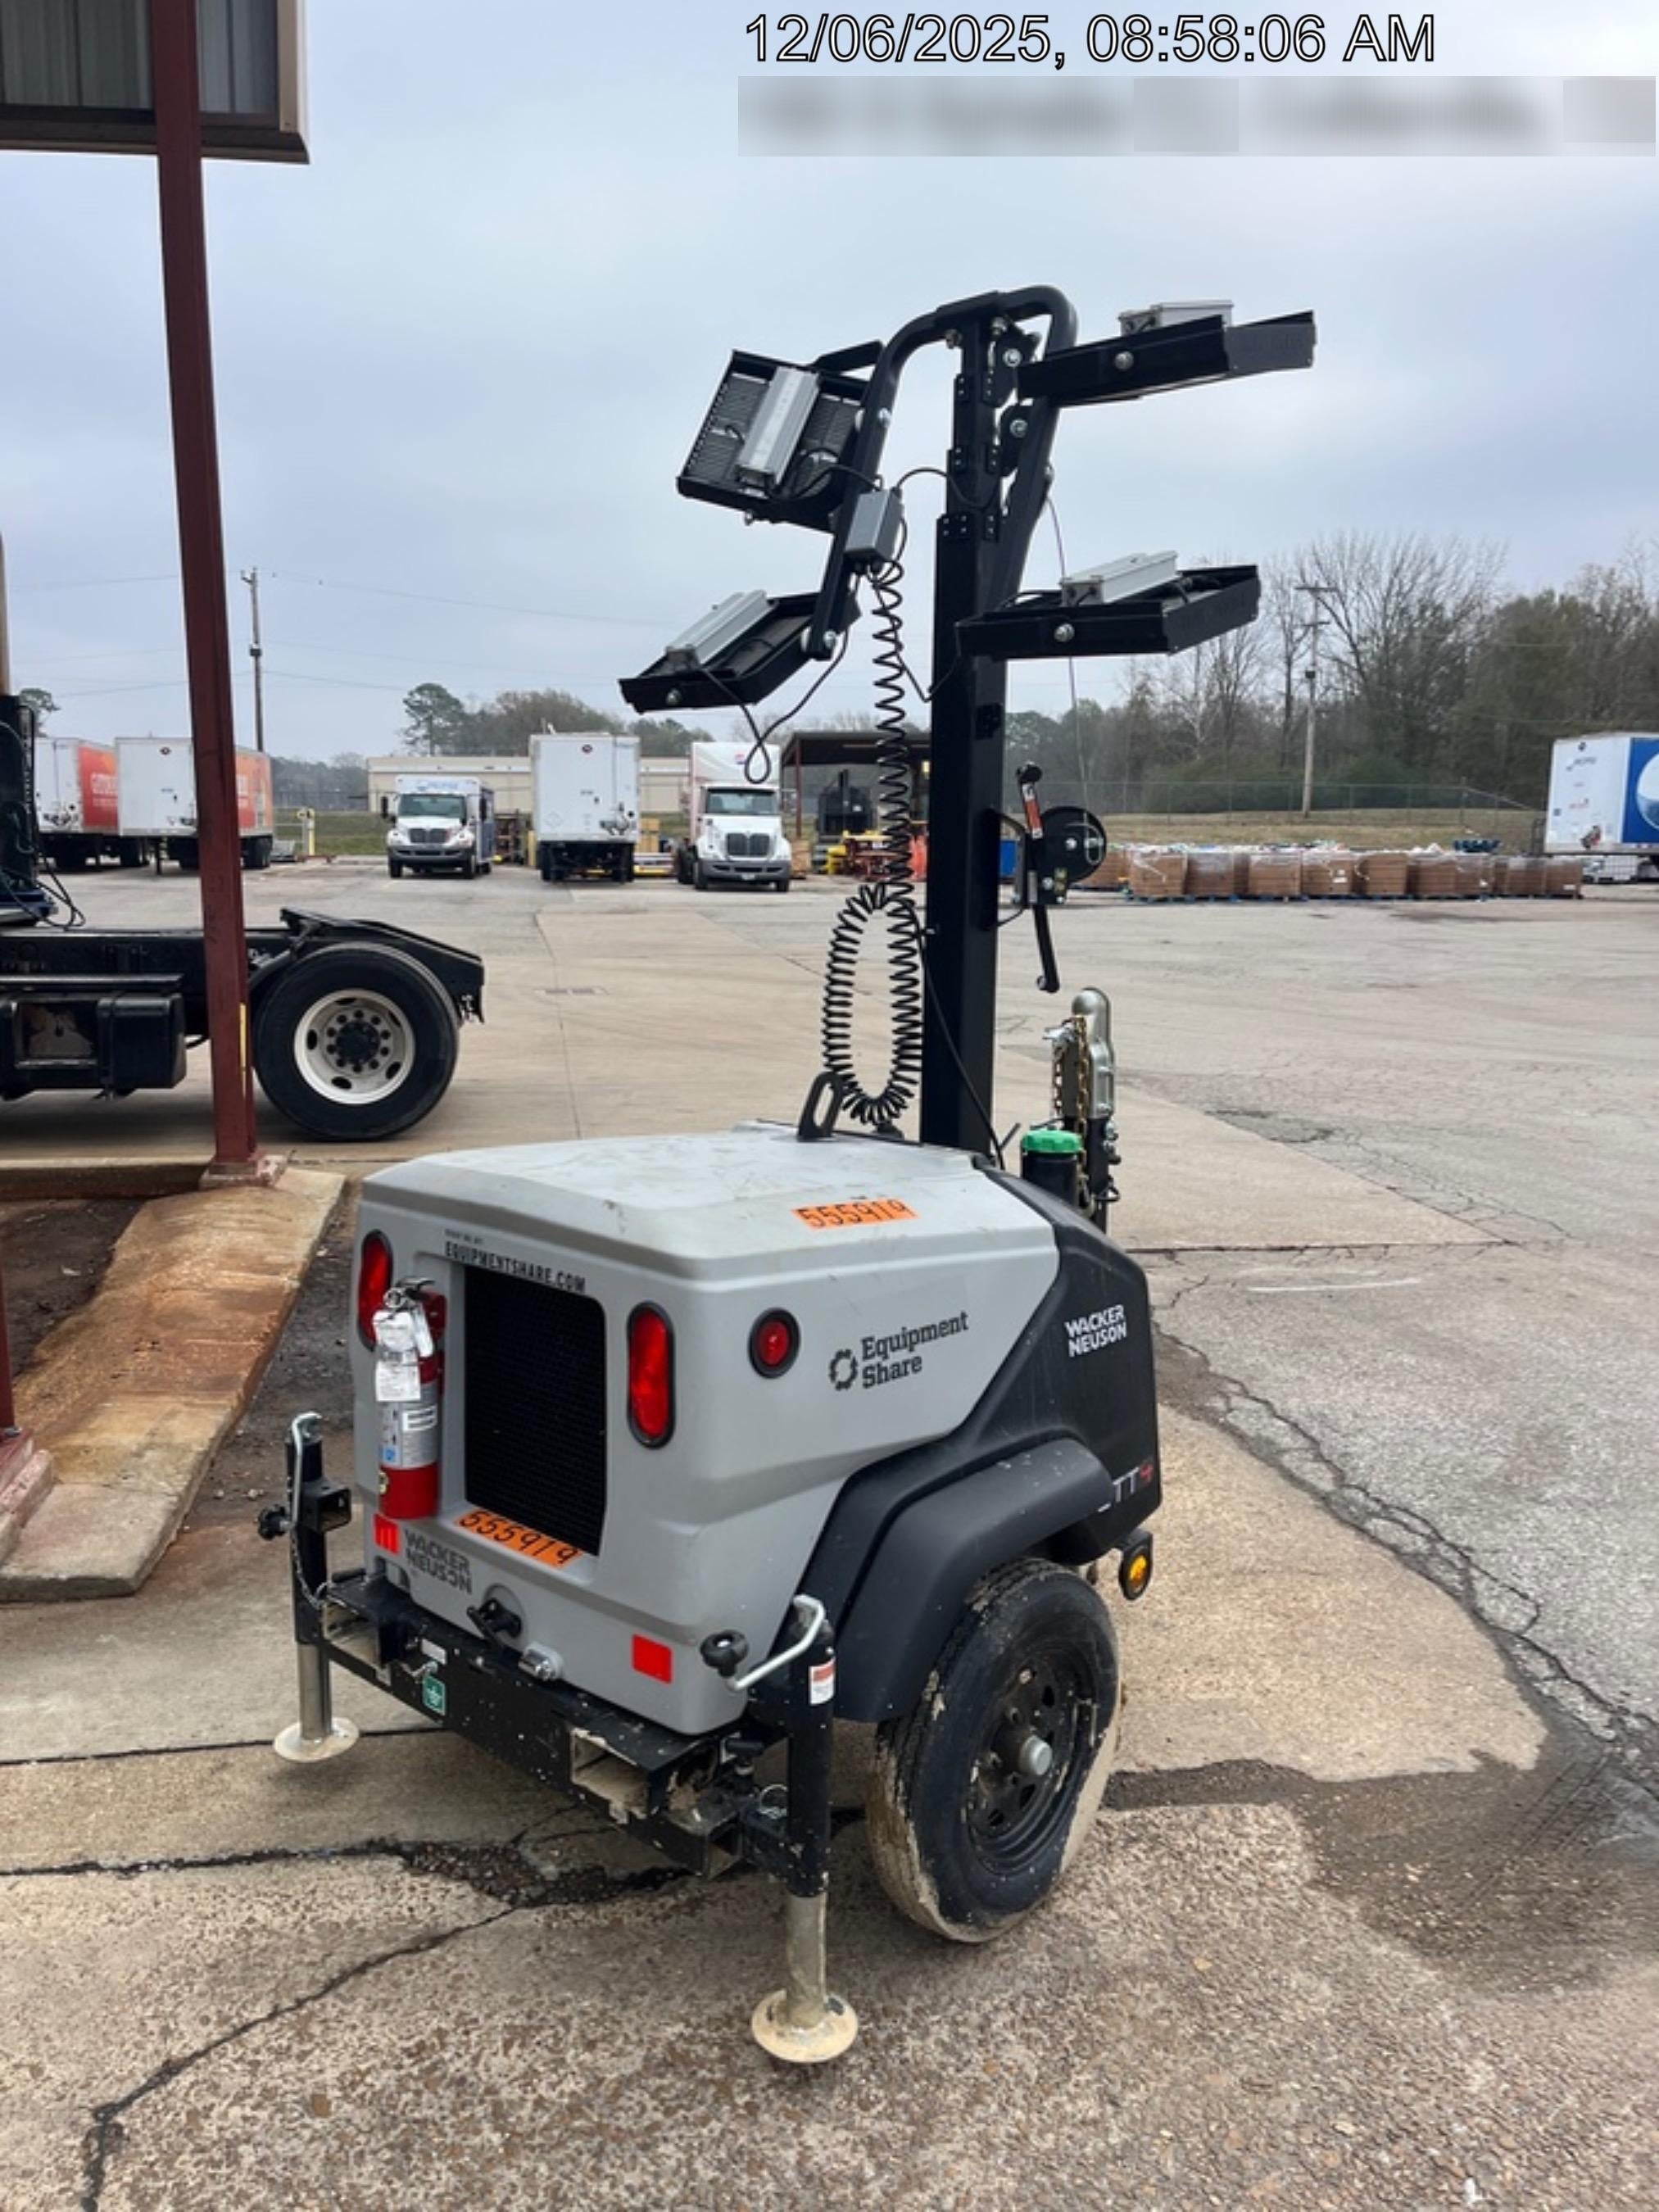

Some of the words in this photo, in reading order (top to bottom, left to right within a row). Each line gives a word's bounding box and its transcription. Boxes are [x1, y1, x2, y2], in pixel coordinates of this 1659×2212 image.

[797, 1199, 916, 1228] 555919
[445, 1240, 586, 1294] EQUIPMENTSHARE.COM
[861, 1311, 969, 1361] Equipment
[1064, 1304, 1125, 1338] WACKER
[1068, 1321, 1126, 1358] NEUSON
[862, 1356, 922, 1389] Share
[404, 1529, 470, 1575] WACKER
[458, 1511, 578, 1565] 555919
[406, 1548, 473, 1595] NEUSON
